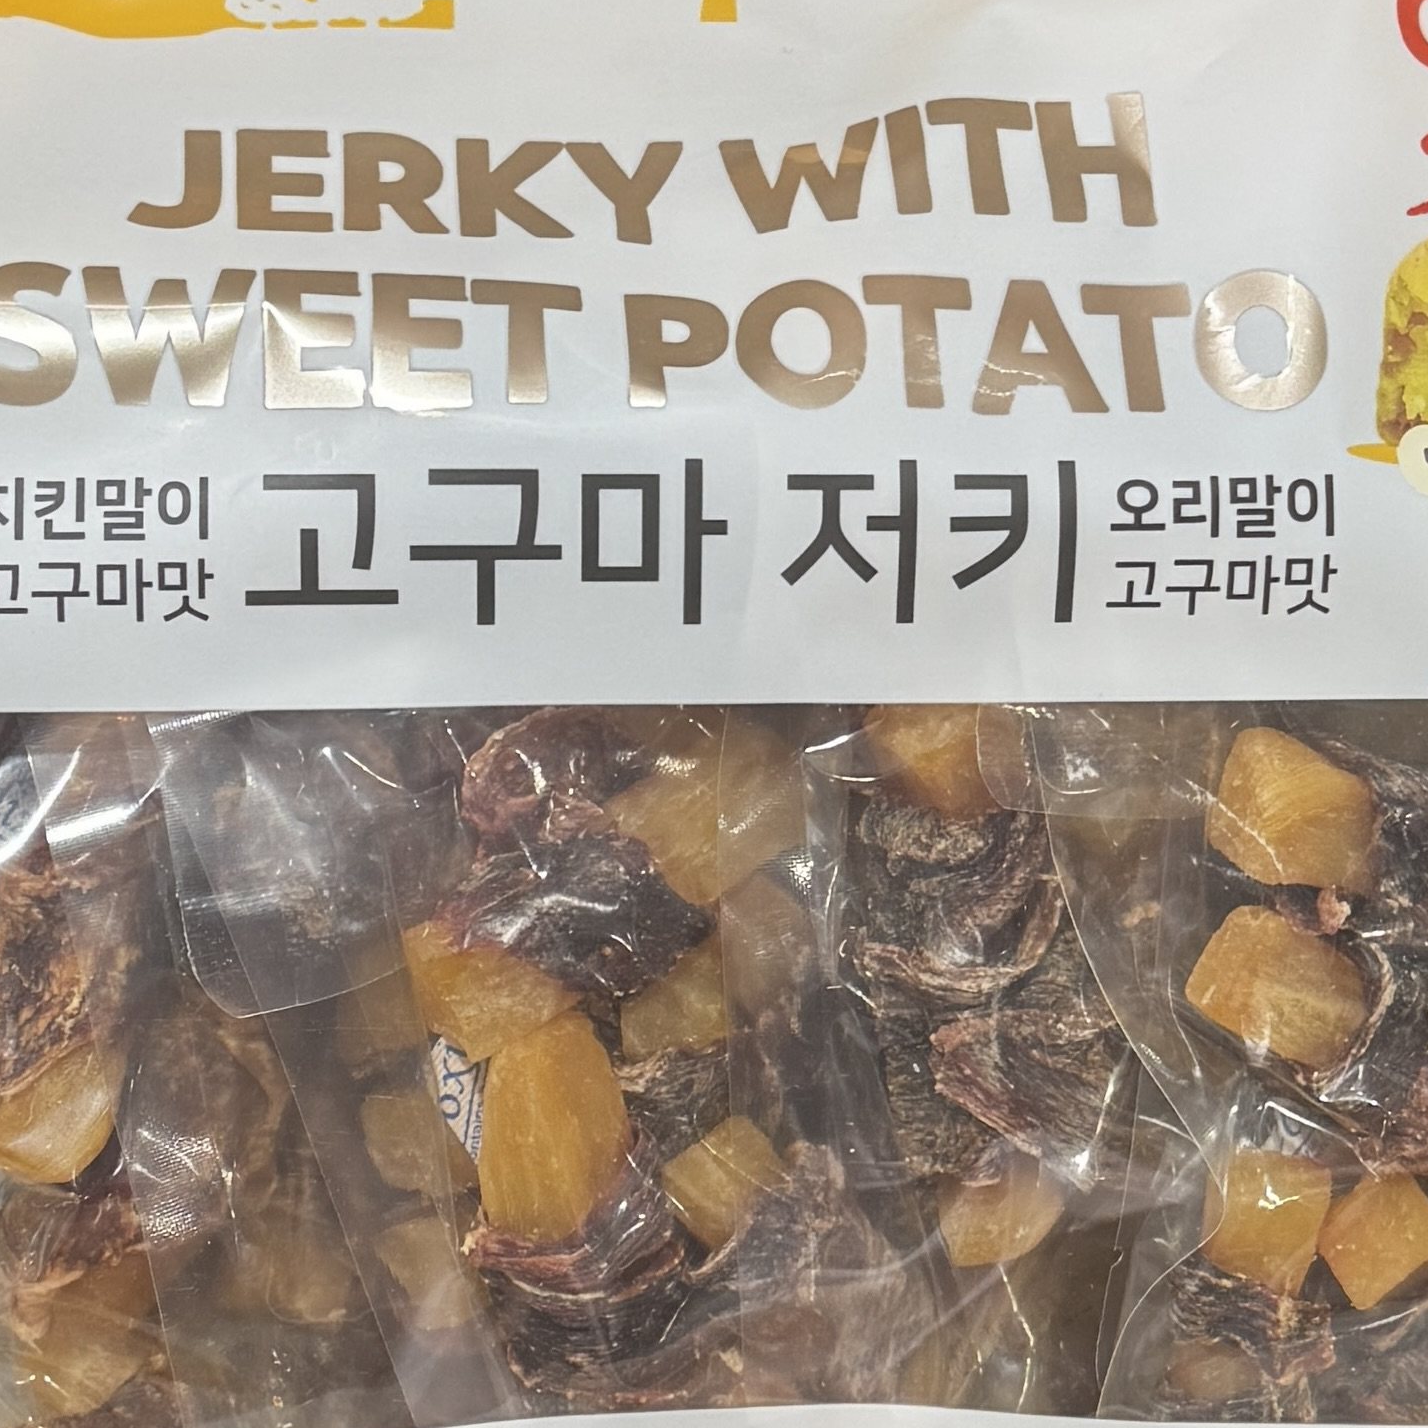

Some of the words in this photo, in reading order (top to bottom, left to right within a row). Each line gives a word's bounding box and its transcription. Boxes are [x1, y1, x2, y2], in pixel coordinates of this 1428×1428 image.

[125, 127, 684, 245] JERKY
[717, 88, 1160, 235] WITH
[626, 266, 1331, 415] POTATO
[243, 458, 731, 626] 고구마
[778, 459, 1079, 626] 저키
[1108, 473, 1337, 539] 오리말이
[1105, 553, 1338, 618] 고구마맛
